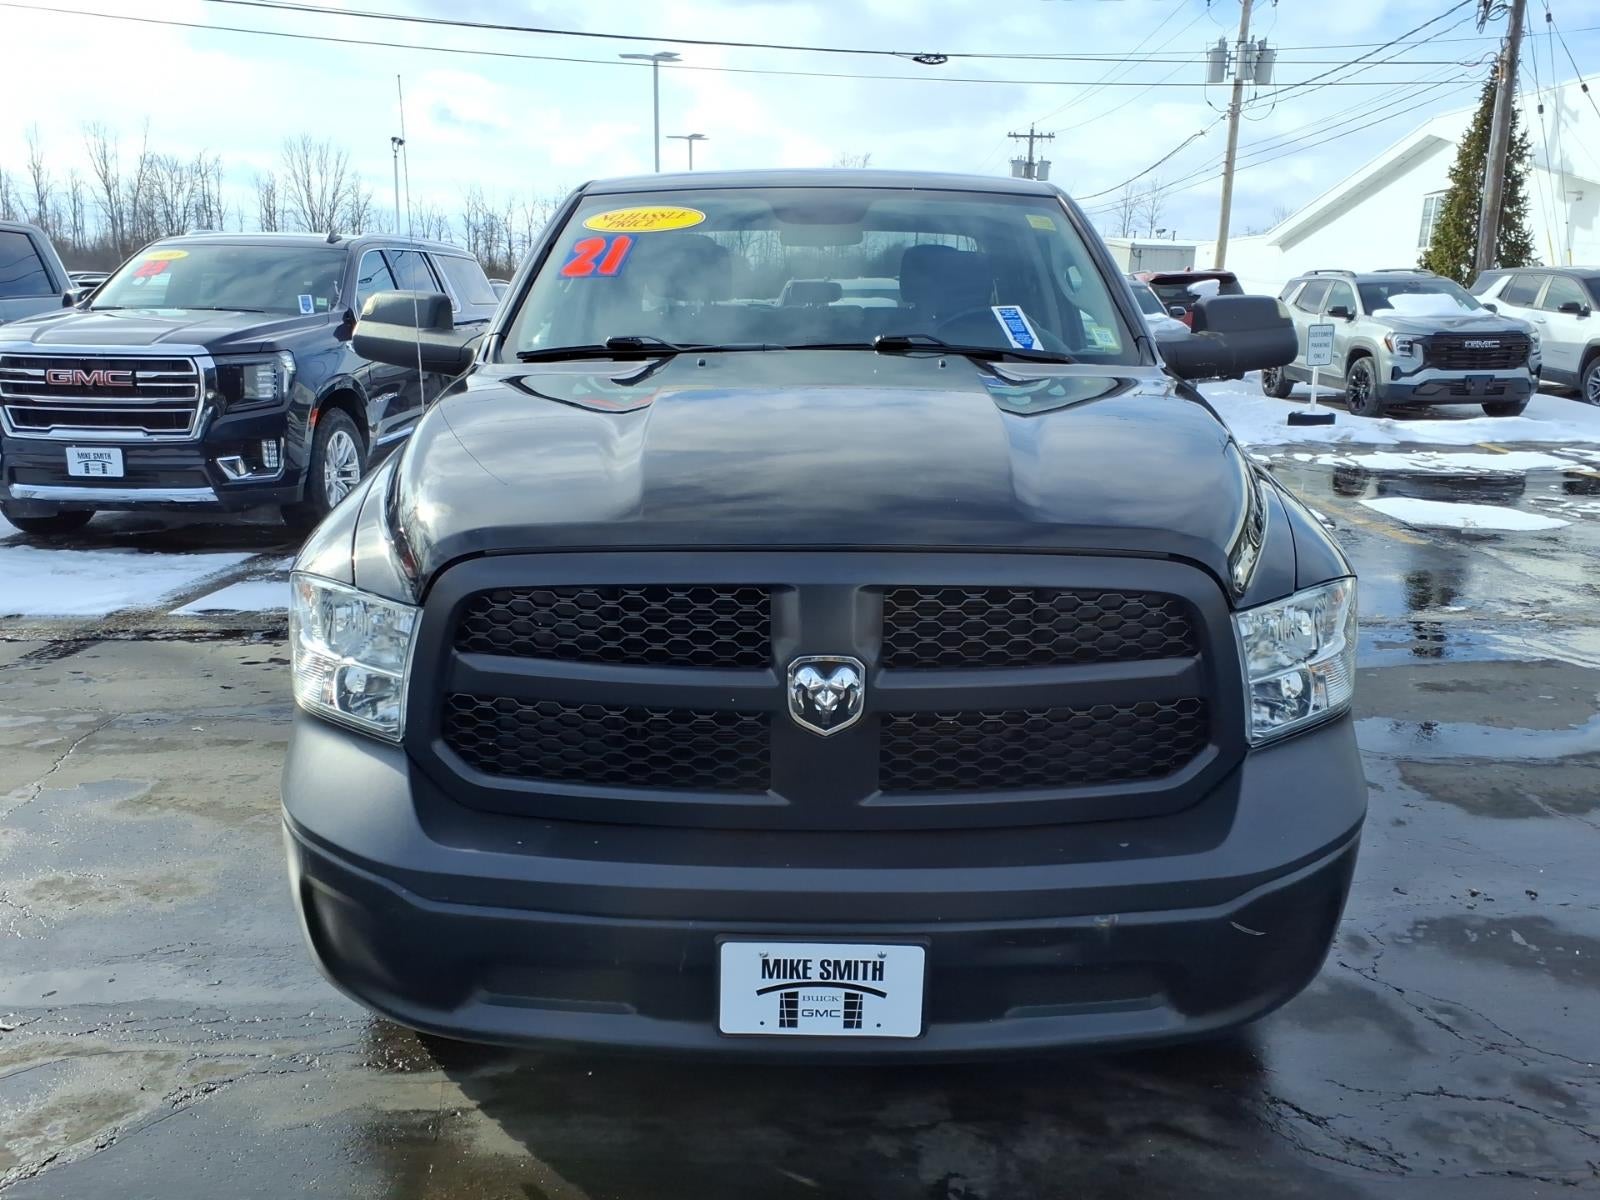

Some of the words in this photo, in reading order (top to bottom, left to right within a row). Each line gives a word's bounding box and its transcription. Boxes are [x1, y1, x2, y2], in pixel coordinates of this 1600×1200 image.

[603, 213, 624, 221] NO
[606, 219, 654, 228] PRICE
[561, 235, 632, 277] 21
[1464, 340, 1501, 348] GMC
[46, 368, 134, 387] GMC
[92, 452, 112, 460] SMITH
[761, 958, 813, 980] MIKE
[819, 959, 885, 982] SMITH
[802, 994, 840, 1002] BUICK
[801, 1008, 841, 1018] GMC
